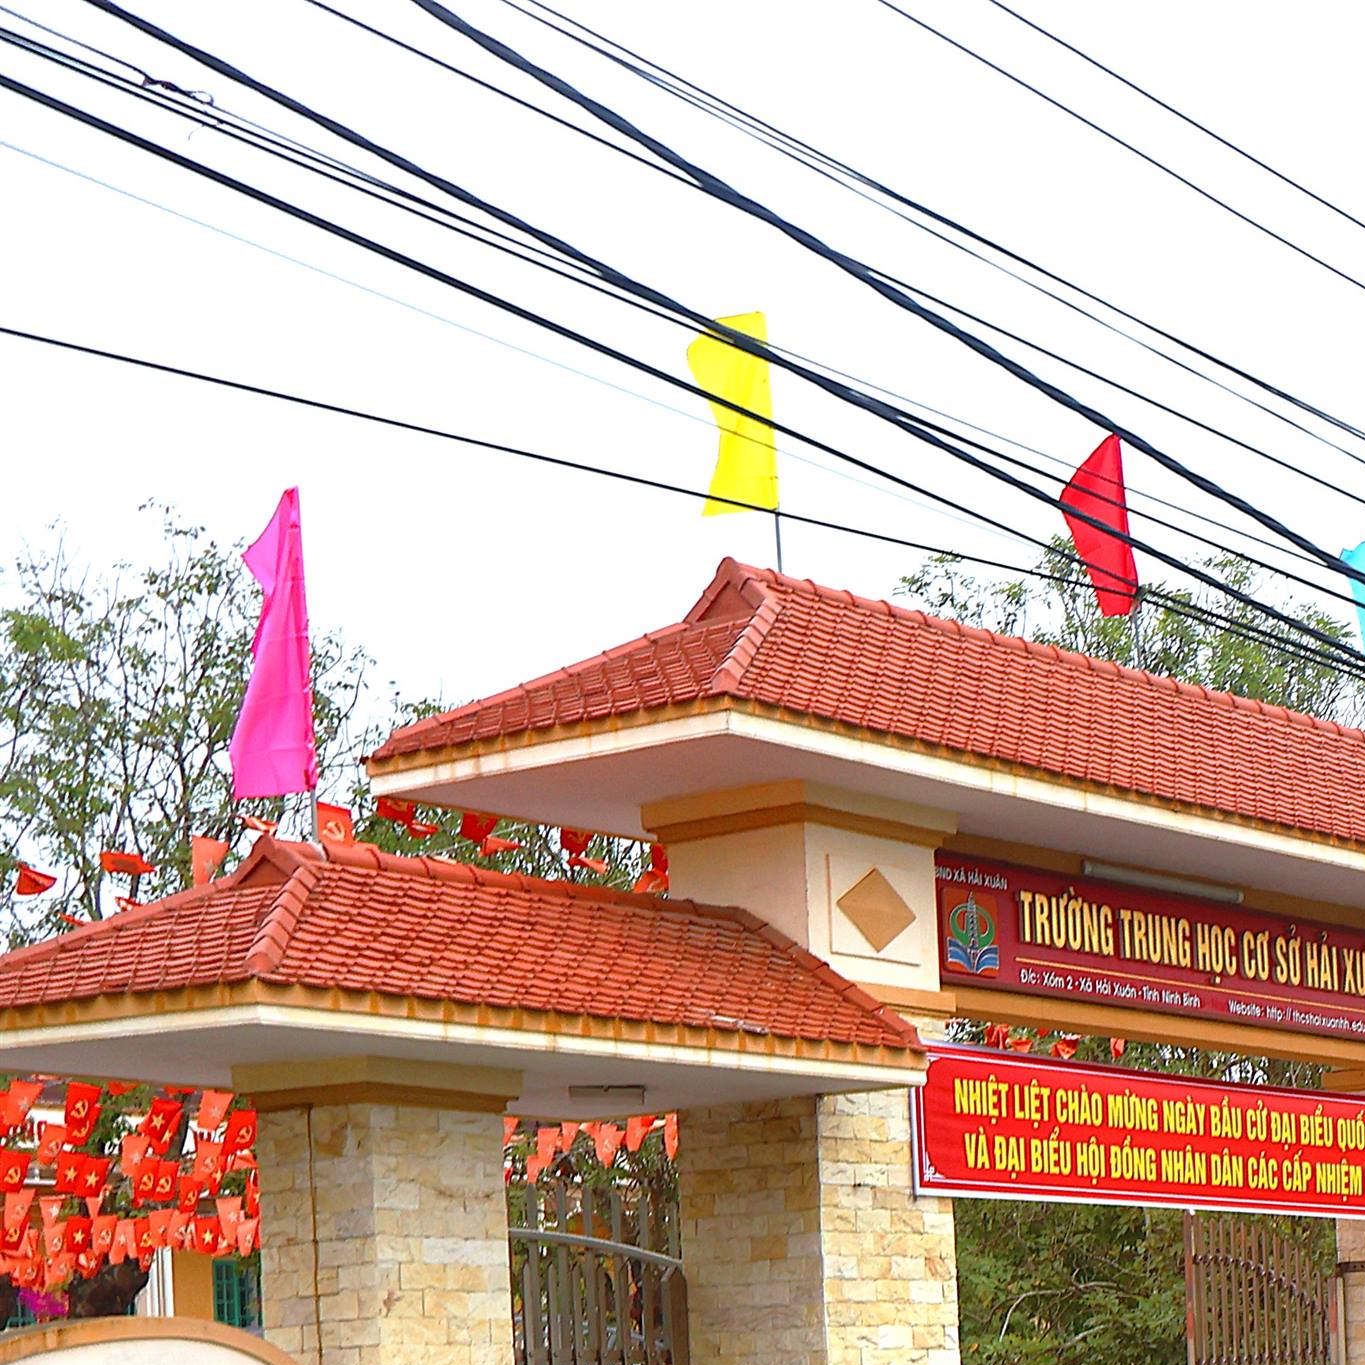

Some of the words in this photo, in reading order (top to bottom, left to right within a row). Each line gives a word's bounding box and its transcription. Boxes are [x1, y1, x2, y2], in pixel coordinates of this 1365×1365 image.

[1019, 886, 1114, 956] TRƯỜNG
[1119, 908, 1191, 968] TRUNG
[1196, 922, 1237, 984] HỌC
[1242, 930, 1270, 981] CƠ
[1275, 923, 1301, 986] SỞ
[1306, 931, 1339, 992] HẢI
[1042, 971, 1065, 989] Xóm
[1066, 975, 1074, 990] 2
[1095, 978, 1111, 995] Hải
[1113, 982, 1137, 999] Xuân
[1161, 989, 1181, 1005] Ninh
[1228, 999, 1265, 1017] Website:
[954, 1074, 1009, 1125] NHIỆT
[1014, 1079, 1051, 1128] LIỆT
[1055, 1084, 1103, 1127] CHÀO
[1107, 1088, 1159, 1132] MỪNG
[1163, 1096, 1206, 1136] NGÀY
[1210, 1095, 1243, 1140] BẦU
[1246, 1100, 1268, 1142] CỬ
[1270, 1111, 1297, 1151] ĐẠI
[1300, 1104, 1334, 1149] BIỂU
[964, 1127, 990, 1169] VÀ
[994, 1136, 1025, 1179] ĐẠI
[1030, 1127, 1071, 1176] BIỂU
[1076, 1136, 1106, 1185] HỘI
[1110, 1135, 1157, 1181] ĐỒNG
[1161, 1145, 1207, 1186] NHÂN
[1211, 1149, 1244, 1188] DÂN
[1248, 1152, 1279, 1190] CÁC
[1282, 1150, 1312, 1193] CẤP
[1315, 1159, 1363, 1202] NHIỆM
